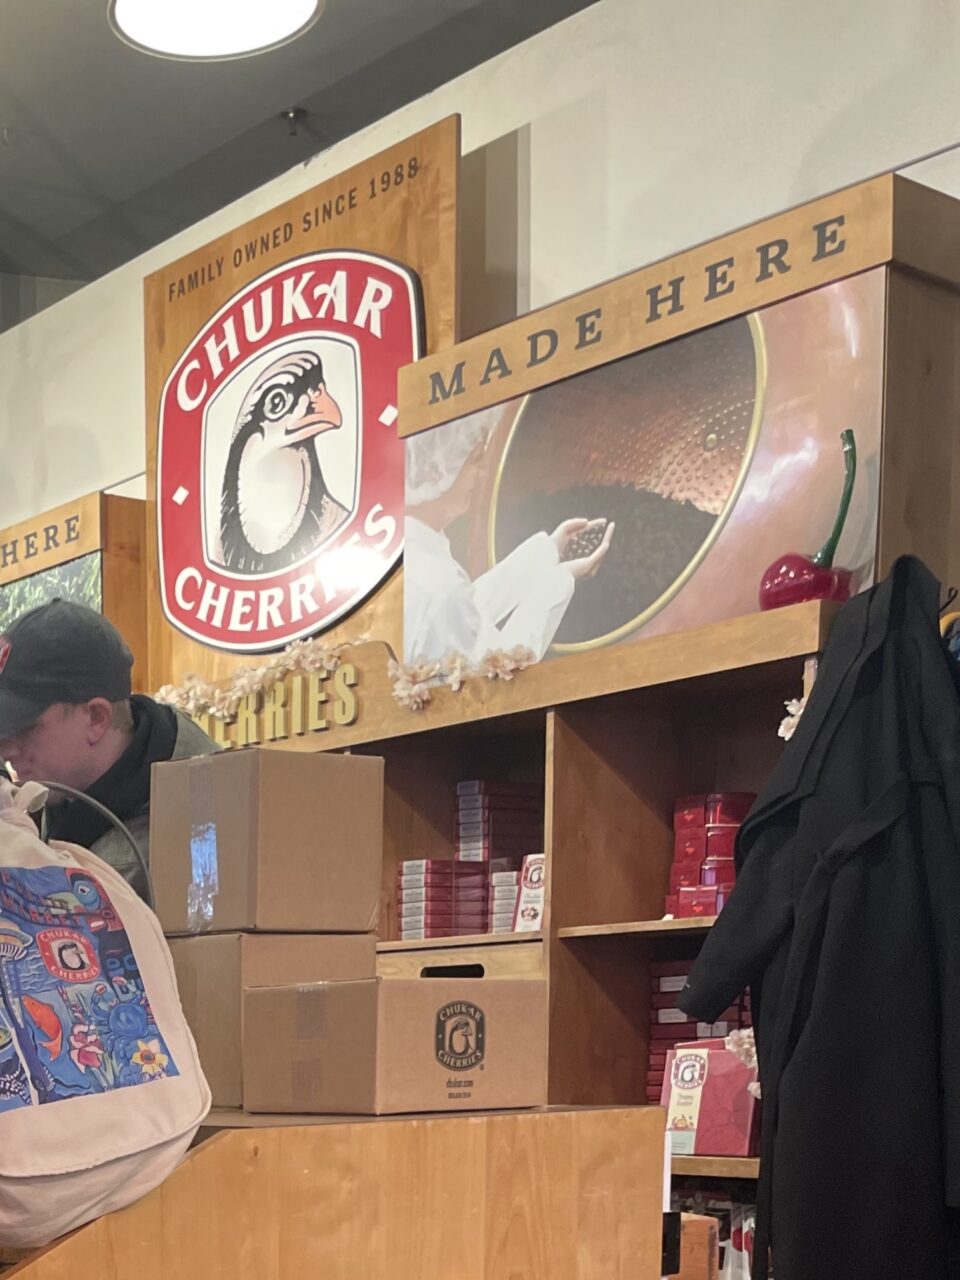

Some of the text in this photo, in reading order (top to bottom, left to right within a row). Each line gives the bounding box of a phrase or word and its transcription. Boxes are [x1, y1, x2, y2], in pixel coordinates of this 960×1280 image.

[168, 156, 419, 302] FAMILY OWNED SINCE 1988
[176, 268, 393, 414] CHUKAR
[428, 216, 848, 405] MADE HERE
[0, 514, 83, 564] HERE
[173, 503, 397, 633] CHERRS
[190, 663, 359, 750] ERRIES
[438, 1050, 482, 1067] CHERRIES
[440, 1004, 481, 1021] CHUKAR
